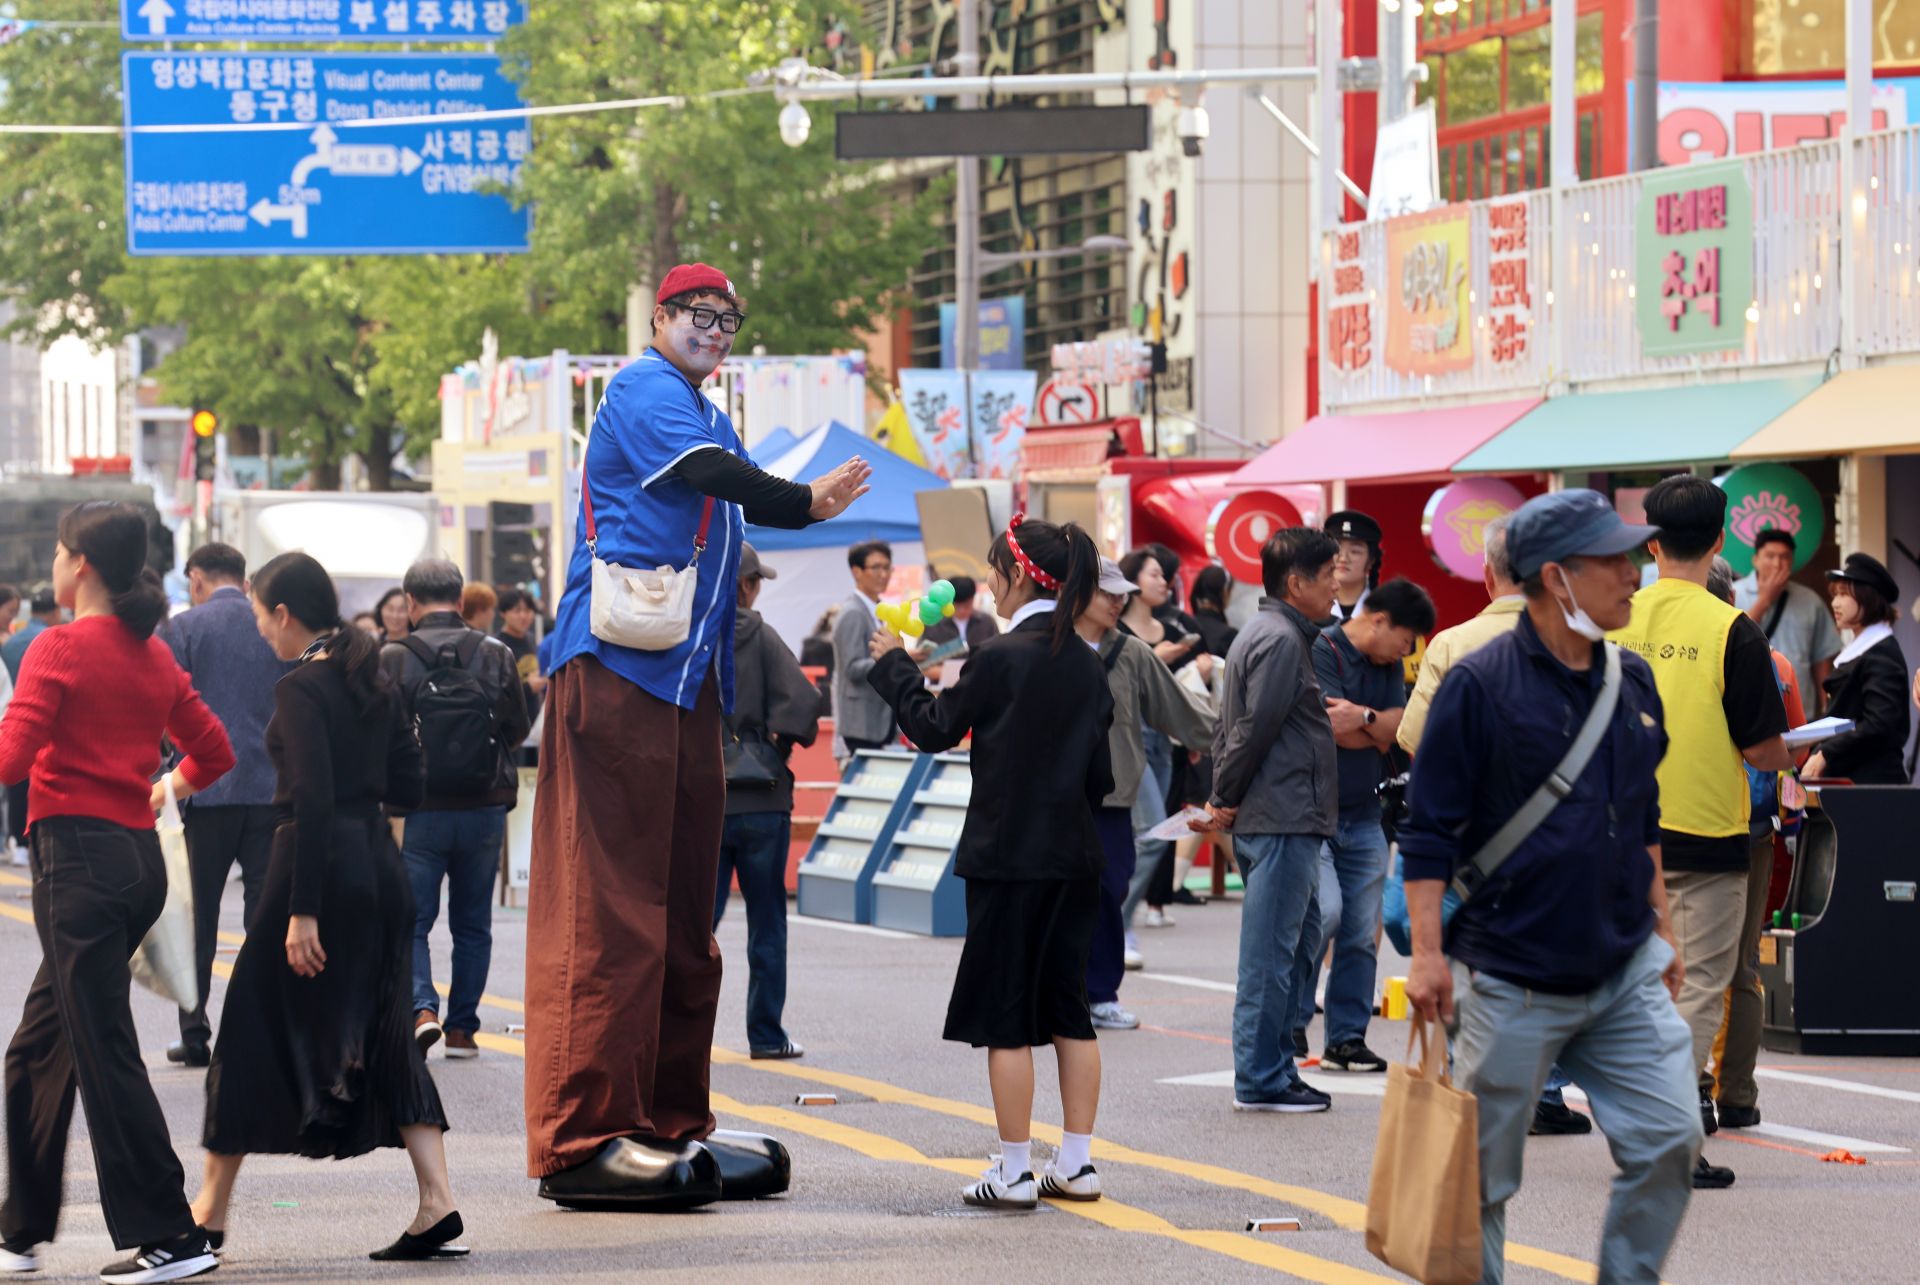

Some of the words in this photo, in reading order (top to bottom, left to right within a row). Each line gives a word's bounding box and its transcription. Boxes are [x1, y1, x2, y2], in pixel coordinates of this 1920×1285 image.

[152, 58, 315, 90] 영상복합문화관
[323, 69, 369, 91] Visual
[372, 69, 431, 91] Content
[435, 69, 484, 91] Center
[229, 90, 317, 121] 동구청
[326, 99, 369, 119] Dong
[372, 99, 431, 118] District
[421, 129, 530, 161] 사직공원
[135, 212, 160, 232] Asia
[161, 211, 204, 232] Culture
[206, 211, 247, 232] Center
[1660, 246, 1722, 333] 추억
